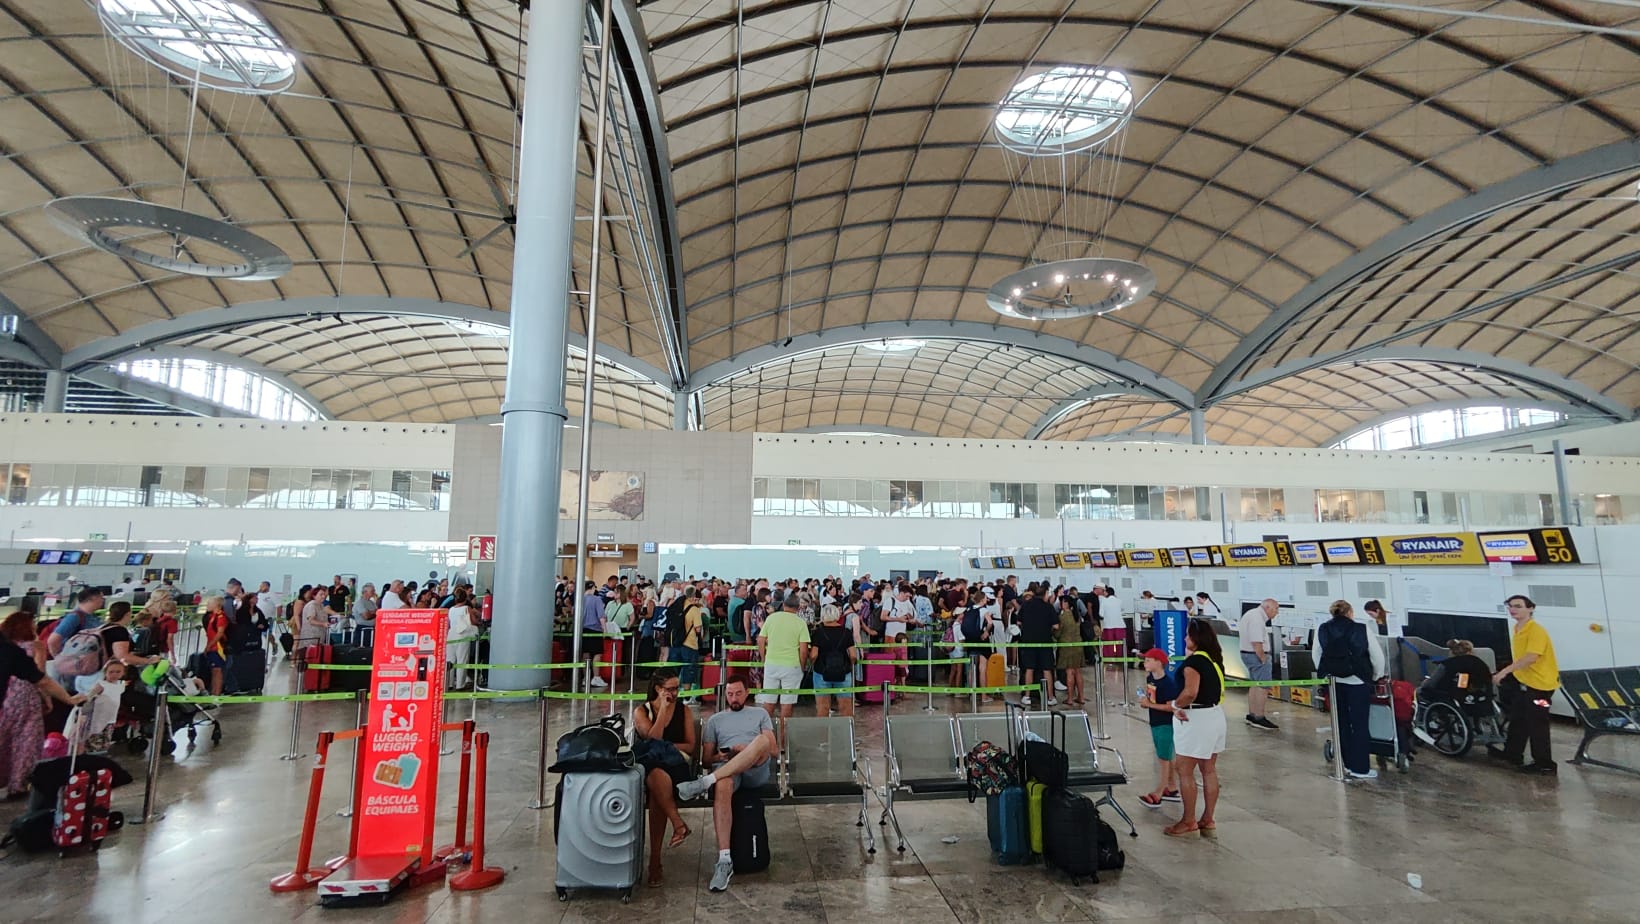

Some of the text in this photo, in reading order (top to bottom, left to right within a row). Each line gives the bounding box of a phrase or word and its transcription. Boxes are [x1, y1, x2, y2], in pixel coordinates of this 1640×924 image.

[1402, 539, 1460, 550] RYANAIR
[1280, 555, 1292, 564] 52
[1366, 552, 1380, 563] 51
[1547, 548, 1572, 562] 50
[373, 742, 416, 752] WEIGHT
